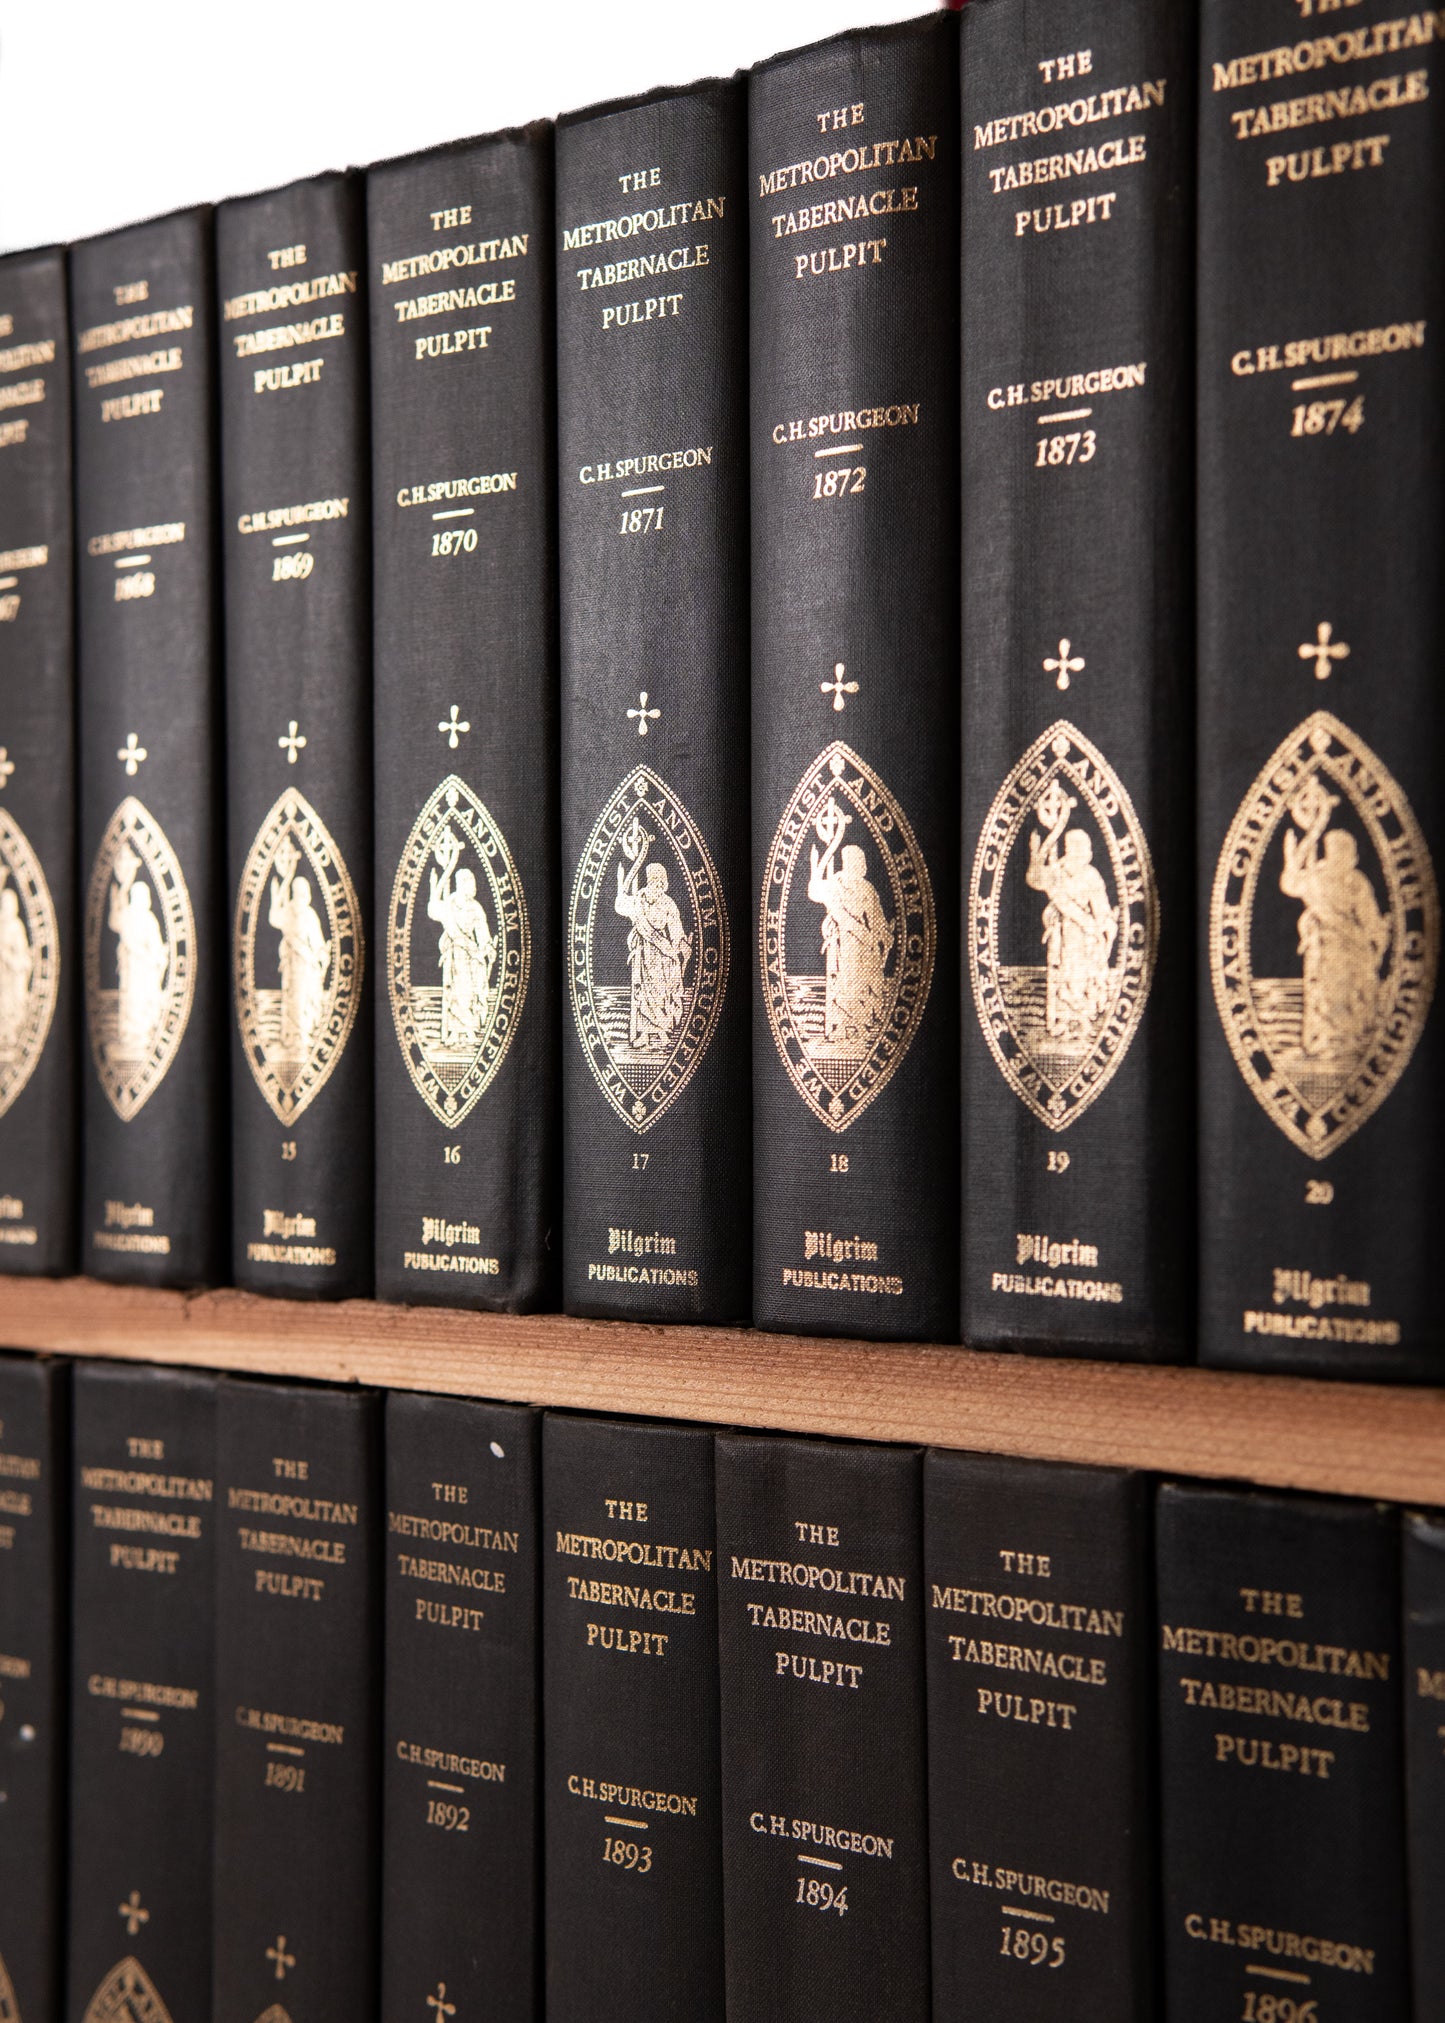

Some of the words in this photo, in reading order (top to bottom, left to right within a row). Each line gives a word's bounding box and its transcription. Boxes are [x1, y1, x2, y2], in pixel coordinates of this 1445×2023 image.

[1038, 49, 1093, 84] THE
[817, 103, 865, 133] THE
[973, 79, 1167, 151] METROPOLITAN
[1231, 69, 1430, 140] TABERNACLE
[619, 168, 661, 193] THE
[759, 136, 938, 198] METROPOLITAN
[989, 135, 1146, 194] TABERNACLE
[1266, 135, 1391, 187] PULPIT
[430, 206, 472, 231] THE
[563, 197, 726, 251] METROPOLITAN
[772, 187, 919, 239] TABERNACLE
[1015, 193, 1116, 236] PULPIT
[267, 245, 307, 270] THE
[382, 234, 529, 285] METROPOLITAN
[577, 245, 710, 291] TABERNACLE
[795, 238, 887, 279] PULPIT
[224, 271, 358, 321] METROPOLITAN
[394, 280, 516, 323] TABERNACLE
[601, 294, 684, 330] PULPIT
[234, 314, 345, 358] TABERNACLE
[415, 326, 492, 360] PULPIT
[254, 359, 324, 393] PULPIT
[1290, 395, 1365, 438] 1874
[1035, 430, 1097, 467] 1873
[813, 466, 867, 499] 1872
[619, 507, 665, 535] 1871
[431, 529, 478, 556] 1870
[272, 553, 314, 581] 1869
[849, 776, 895, 833] AND
[1071, 758, 1119, 818] AND
[652, 799, 692, 851] AND
[774, 772, 827, 885] CHRIST
[983, 753, 1047, 872] CHRIST
[461, 808, 498, 858] AND
[581, 797, 632, 900] CHRIST
[894, 852, 923, 916] HIM
[1117, 835, 1144, 904] HIM
[497, 872, 519, 931] HIM
[692, 870, 717, 928] HIM
[574, 924, 601, 1047] PREACH
[765, 911, 794, 1039] PREACH
[976, 897, 1008, 1036] PREACH
[461, 950, 520, 1099] CRUCIFIED
[652, 947, 719, 1103] CRUCIFIED
[849, 935, 923, 1100] CRUCIFIED
[1069, 921, 1145, 1098] CRUCIFIED
[601, 1063, 627, 1102] WE
[795, 1058, 822, 1100] WE
[443, 1146, 461, 1165] 16
[631, 1153, 649, 1170] 17
[829, 1153, 849, 1173] 18
[1047, 1150, 1071, 1175] 19
[1304, 1180, 1334, 1204] 20
[422, 1217, 481, 1247] Pilgrim
[607, 1227, 677, 1257] Pilgrim
[804, 1231, 878, 1263] Pilgrim
[1016, 1233, 1099, 1268] Pilgrim
[404, 1252, 500, 1275] PUBLICATIONS
[588, 1263, 698, 1287] PUBLICATIONS
[782, 1269, 904, 1296] PUBLICATIONS
[990, 1272, 1124, 1303] PUBLICATIONS
[1272, 1267, 1371, 1307] Pilgrim
[1243, 1310, 1401, 1346] PUBLICATIONS
[273, 1458, 309, 1481] THE
[228, 1487, 358, 1526] METROPOLITAN
[432, 1483, 469, 1504] THE
[605, 1499, 649, 1522] THE
[238, 1527, 346, 1564] TABERNACLE
[389, 1511, 519, 1553] METROPOLITAN
[555, 1532, 713, 1572] METROPOLITAN
[794, 1521, 840, 1547] THE
[398, 1554, 506, 1594] TABERNACLE
[730, 1556, 906, 1601] METROPOLITAN
[1000, 1549, 1051, 1577] THE
[255, 1570, 324, 1601] PULPIT
[567, 1576, 696, 1616] TABERNACLE
[1240, 1587, 1304, 1619] THE
[415, 1599, 484, 1631] PULPIT
[747, 1602, 892, 1647] TABERNACLE
[931, 1584, 1124, 1637] METROPOLITAN
[586, 1623, 668, 1657] PULPIT
[948, 1635, 1107, 1685] TABERNACLE
[1162, 1624, 1390, 1681] METROPOLITAN
[775, 1652, 863, 1689] PULPIT
[977, 1688, 1077, 1730] PULPIT
[1180, 1676, 1370, 1733] TABERNACLE
[1214, 1733, 1335, 1778] PULPIT
[265, 1762, 305, 1793] 1891
[427, 1801, 470, 1831] 1892
[602, 1837, 653, 1874] 1893
[795, 1877, 849, 1917] 1894
[999, 1926, 1066, 1968] 1895
[1241, 1991, 1318, 2023] 1896
